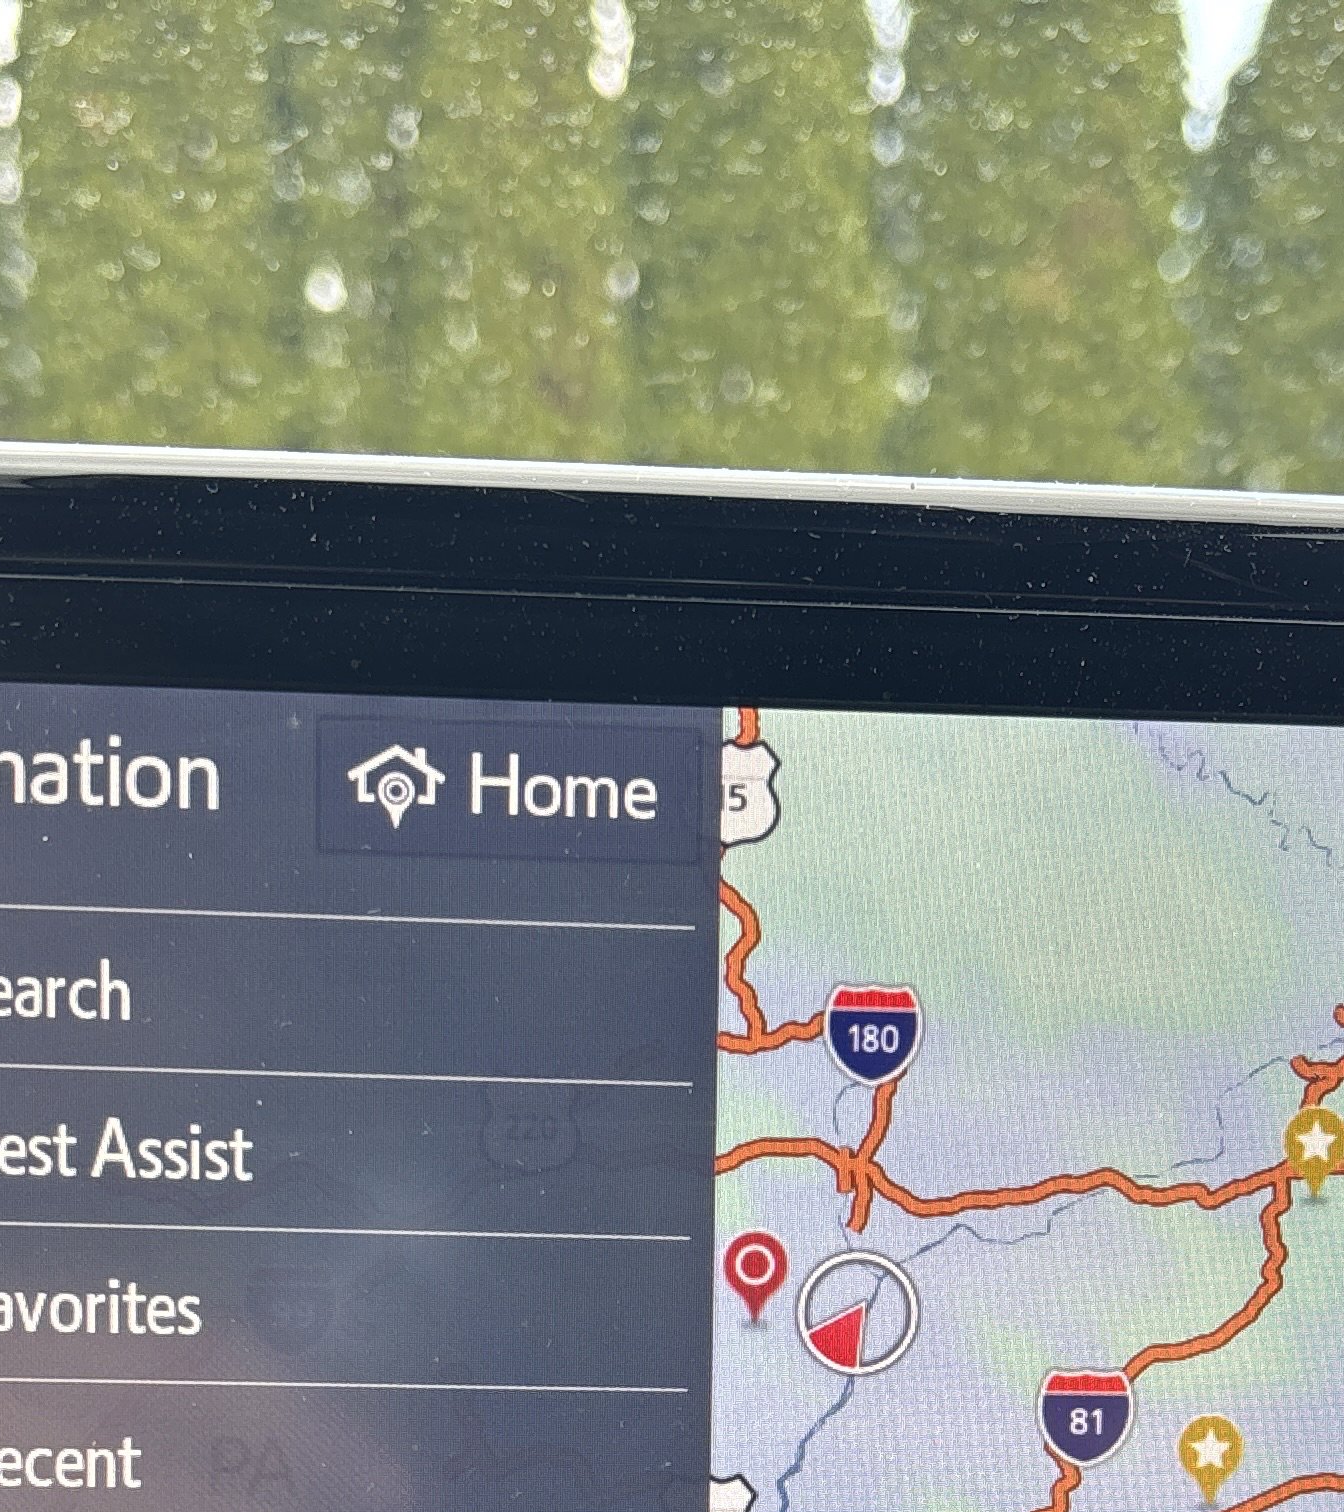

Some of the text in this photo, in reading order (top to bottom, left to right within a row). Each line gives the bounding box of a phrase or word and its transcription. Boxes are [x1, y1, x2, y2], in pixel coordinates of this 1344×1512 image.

[472, 752, 657, 819] Home
[849, 1024, 899, 1053] 180
[91, 1117, 253, 1181] Assist
[1070, 1408, 1102, 1435] 81
[210, 1437, 296, 1497] PA
